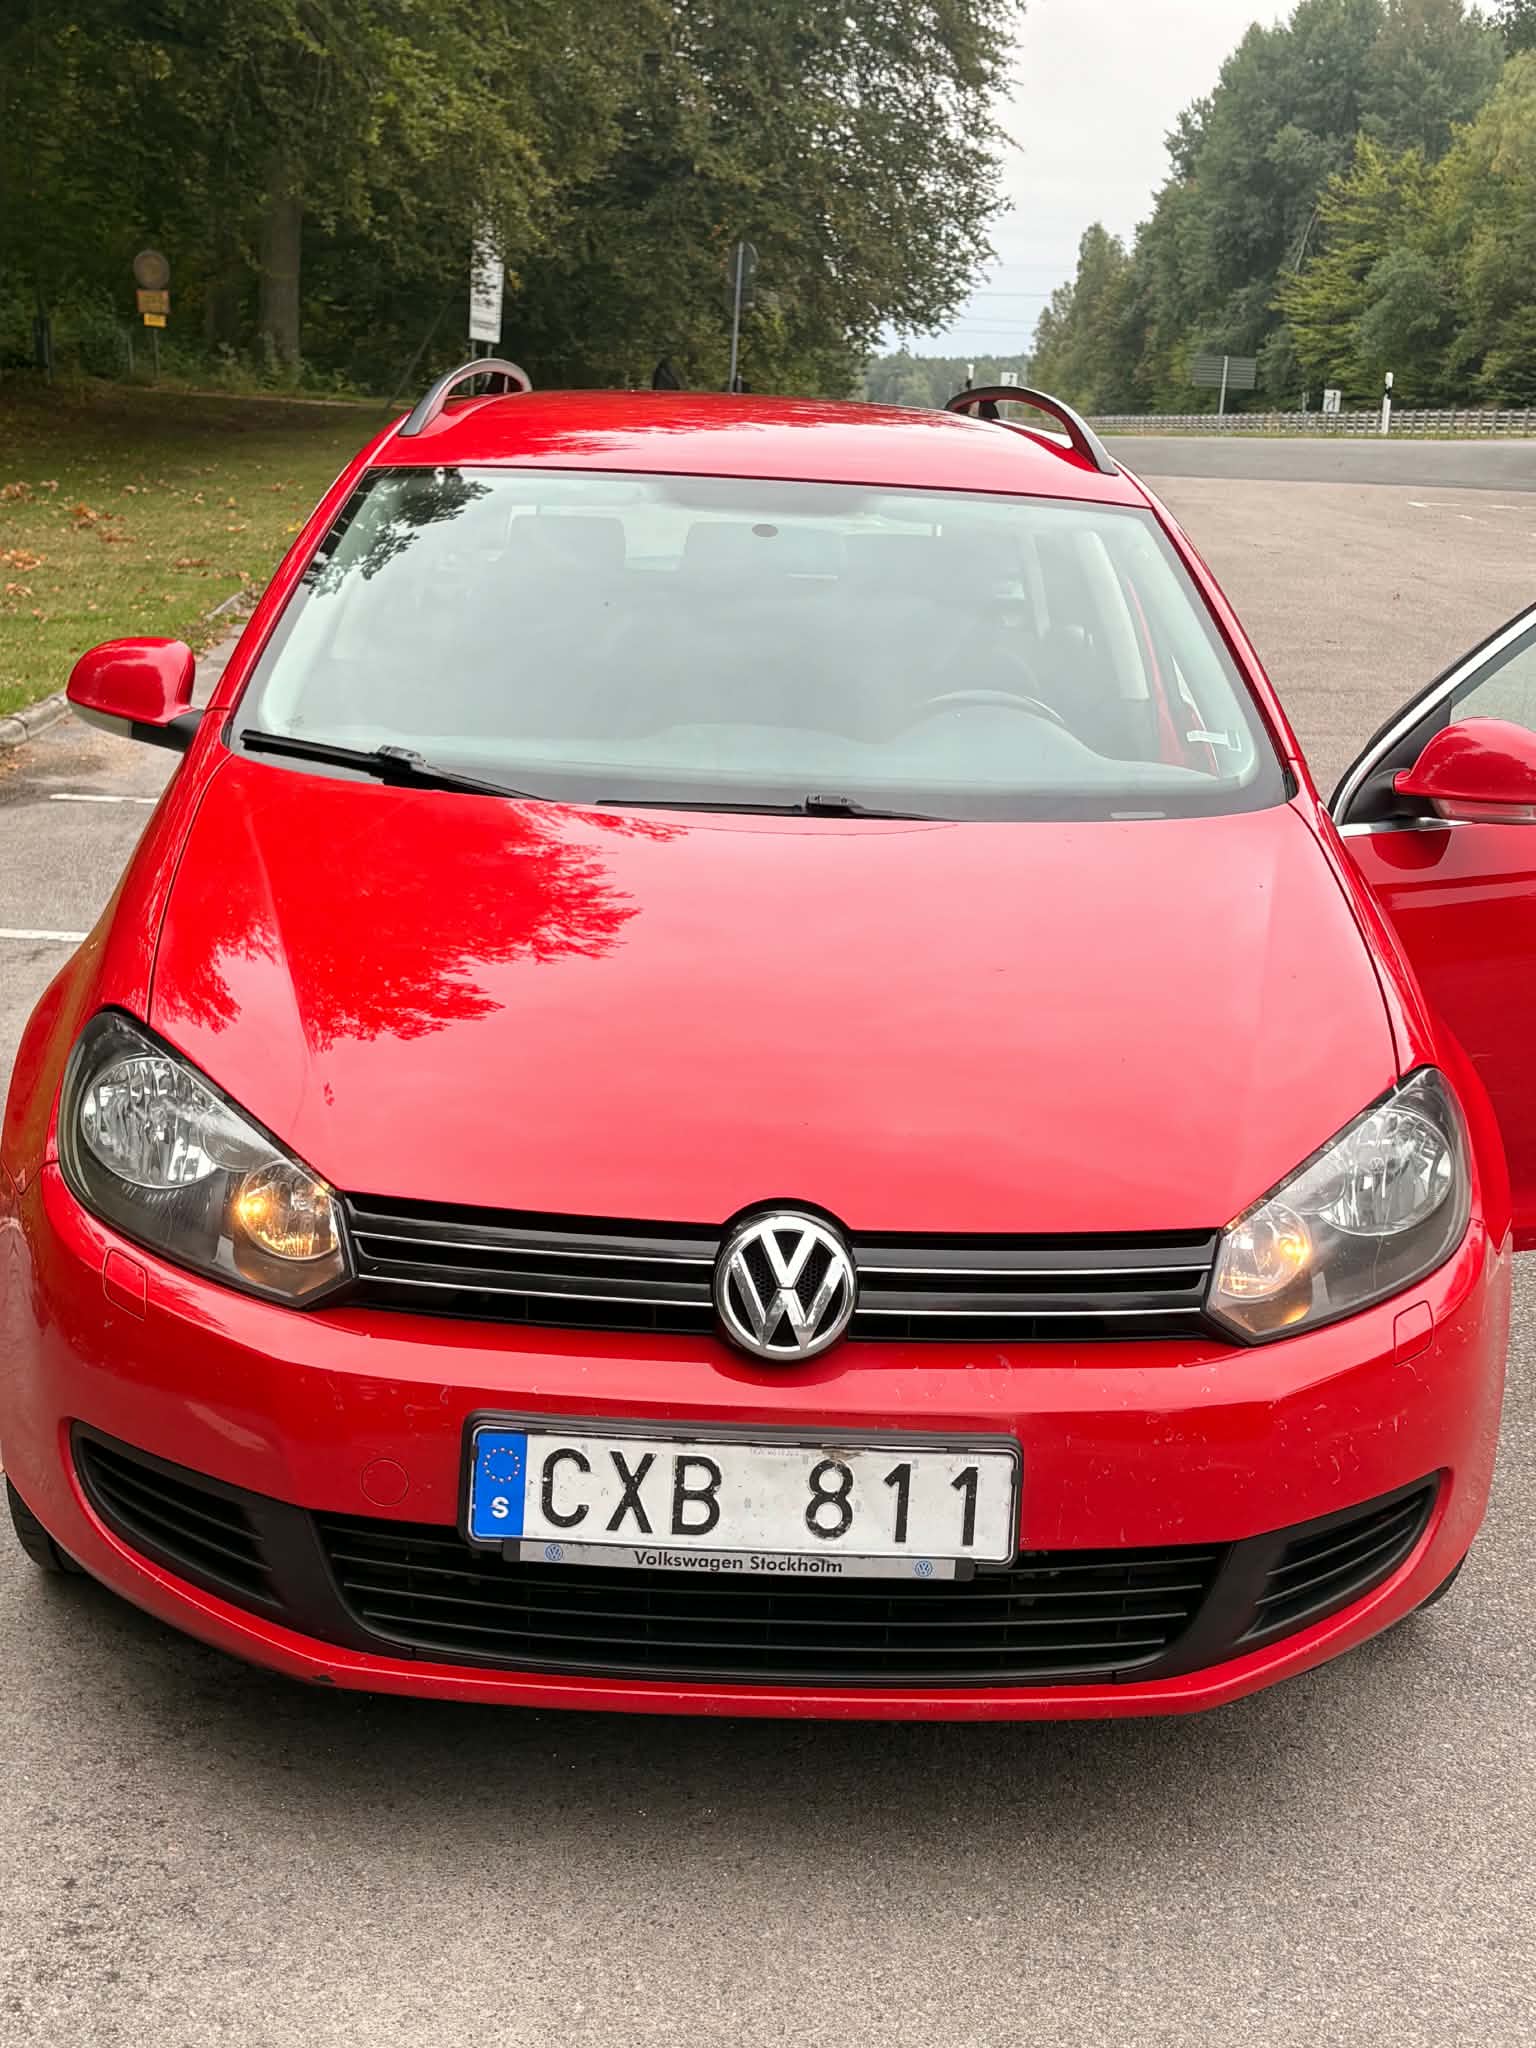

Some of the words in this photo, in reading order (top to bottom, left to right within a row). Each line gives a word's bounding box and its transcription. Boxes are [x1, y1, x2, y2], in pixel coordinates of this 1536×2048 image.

[722, 1220, 850, 1353] VW
[491, 1497, 510, 1519] S
[541, 1448, 722, 1536] CXB
[805, 1459, 979, 1547] 811
[634, 1550, 744, 1572] Volkswagen
[750, 1555, 843, 1574] Stockholm
